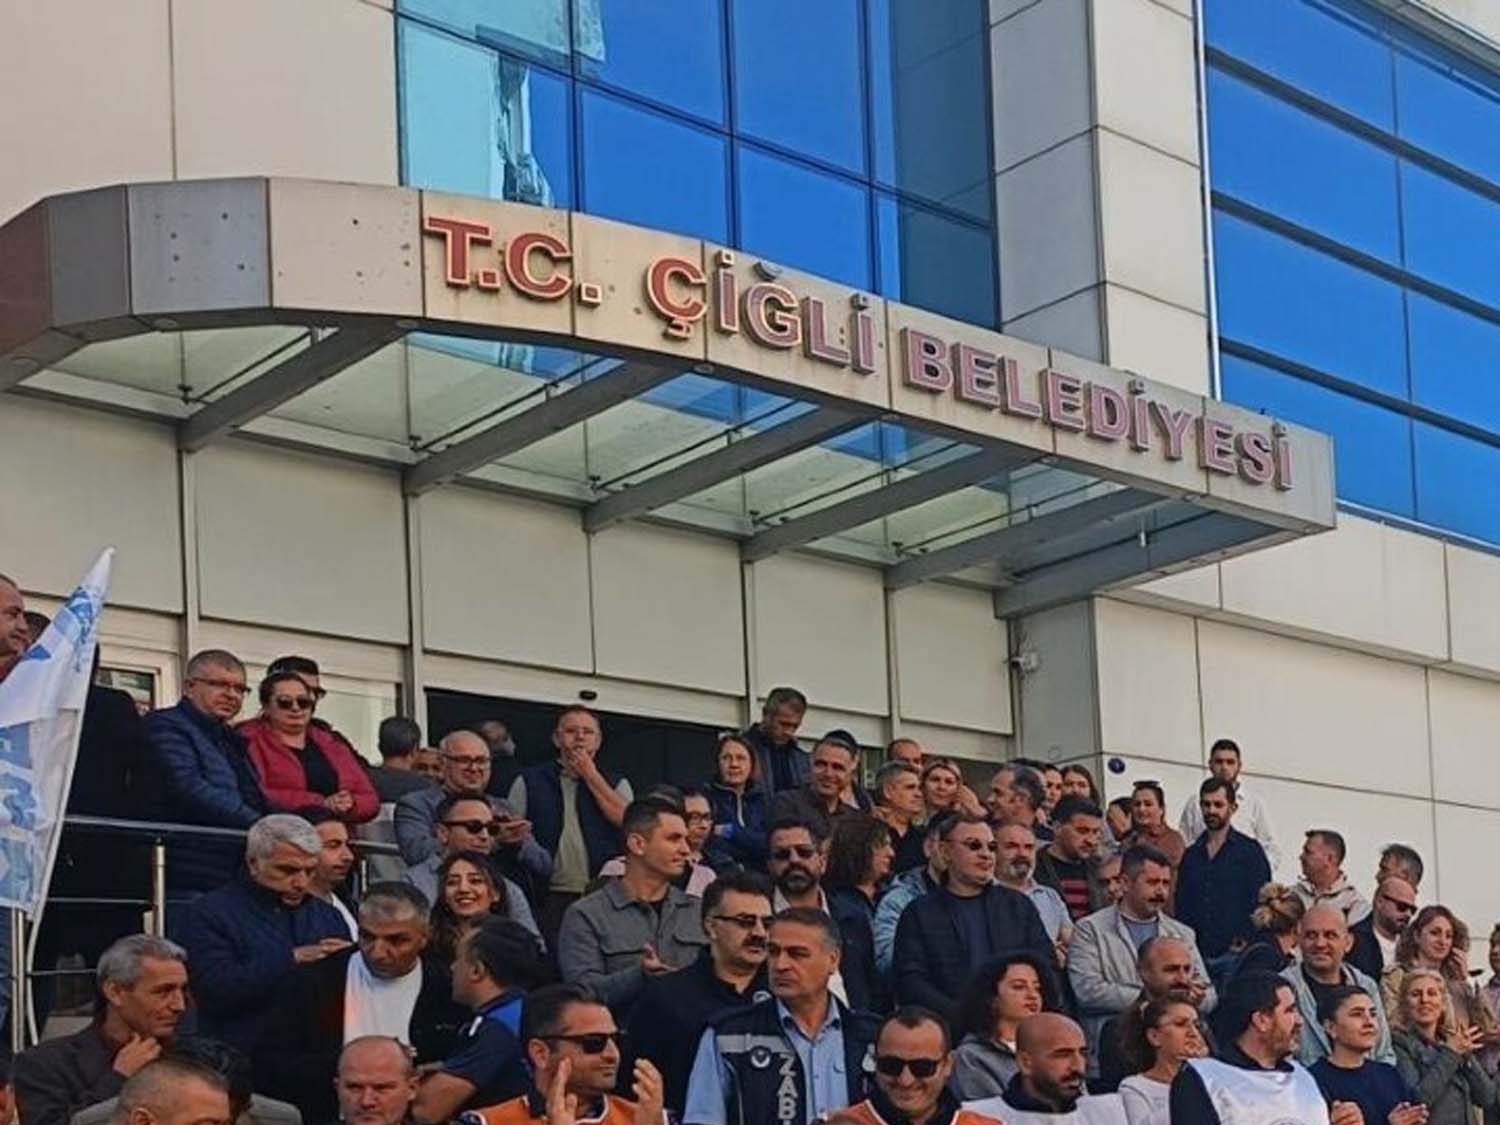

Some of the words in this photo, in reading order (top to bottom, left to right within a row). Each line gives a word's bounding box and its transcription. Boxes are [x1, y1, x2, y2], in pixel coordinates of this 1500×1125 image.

[426, 215, 603, 306] T.C.
[645, 249, 877, 374] ÇİĞLİ
[902, 326, 1295, 492] BELEDİYESİ
